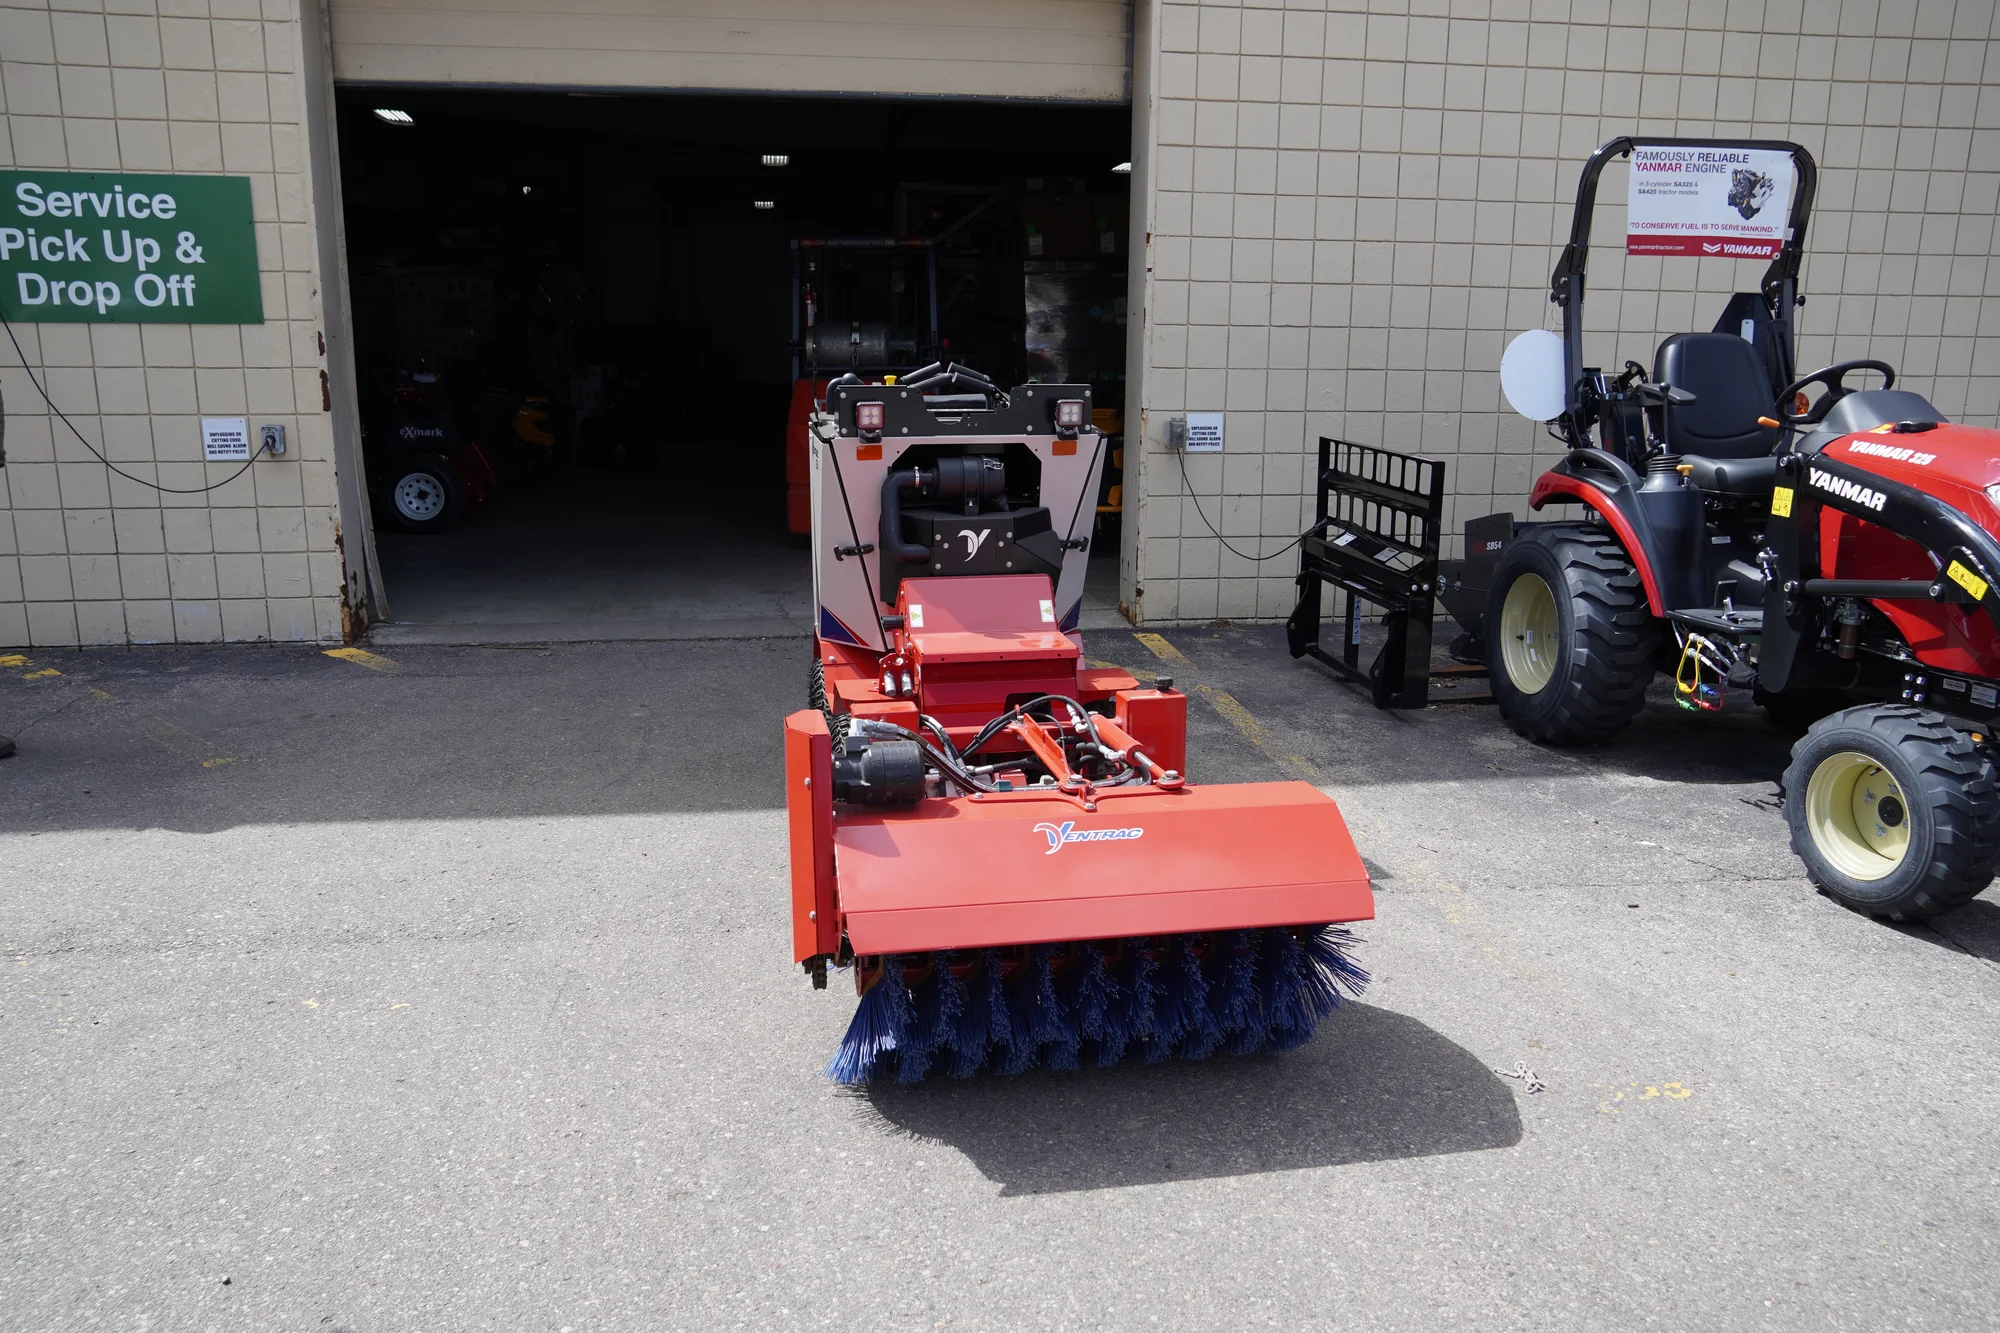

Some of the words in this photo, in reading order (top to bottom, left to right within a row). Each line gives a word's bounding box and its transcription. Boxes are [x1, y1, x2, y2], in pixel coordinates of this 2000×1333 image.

[1635, 151, 1695, 162] FAMOUSLY
[1697, 152, 1750, 164] RELIABLE
[1635, 162, 1682, 173] YANMAR
[1684, 163, 1727, 174] ENGINE
[15, 181, 177, 220] Service
[1640, 222, 1679, 230] CONSERVE
[1720, 224, 1740, 232] SERVE
[0, 227, 91, 262] Pick
[102, 229, 161, 271] Up
[175, 230, 206, 264] &
[1723, 244, 1772, 255] YANMAR
[17, 272, 121, 314] Drop
[134, 273, 196, 307] Off
[399, 426, 443, 438] eXmark
[1848, 440, 1915, 462] YANMAR
[1908, 452, 1937, 466] 325
[1809, 467, 1887, 512] YANMAR
[1486, 540, 1502, 551] SB54
[1033, 821, 1144, 855] VENTRAC
